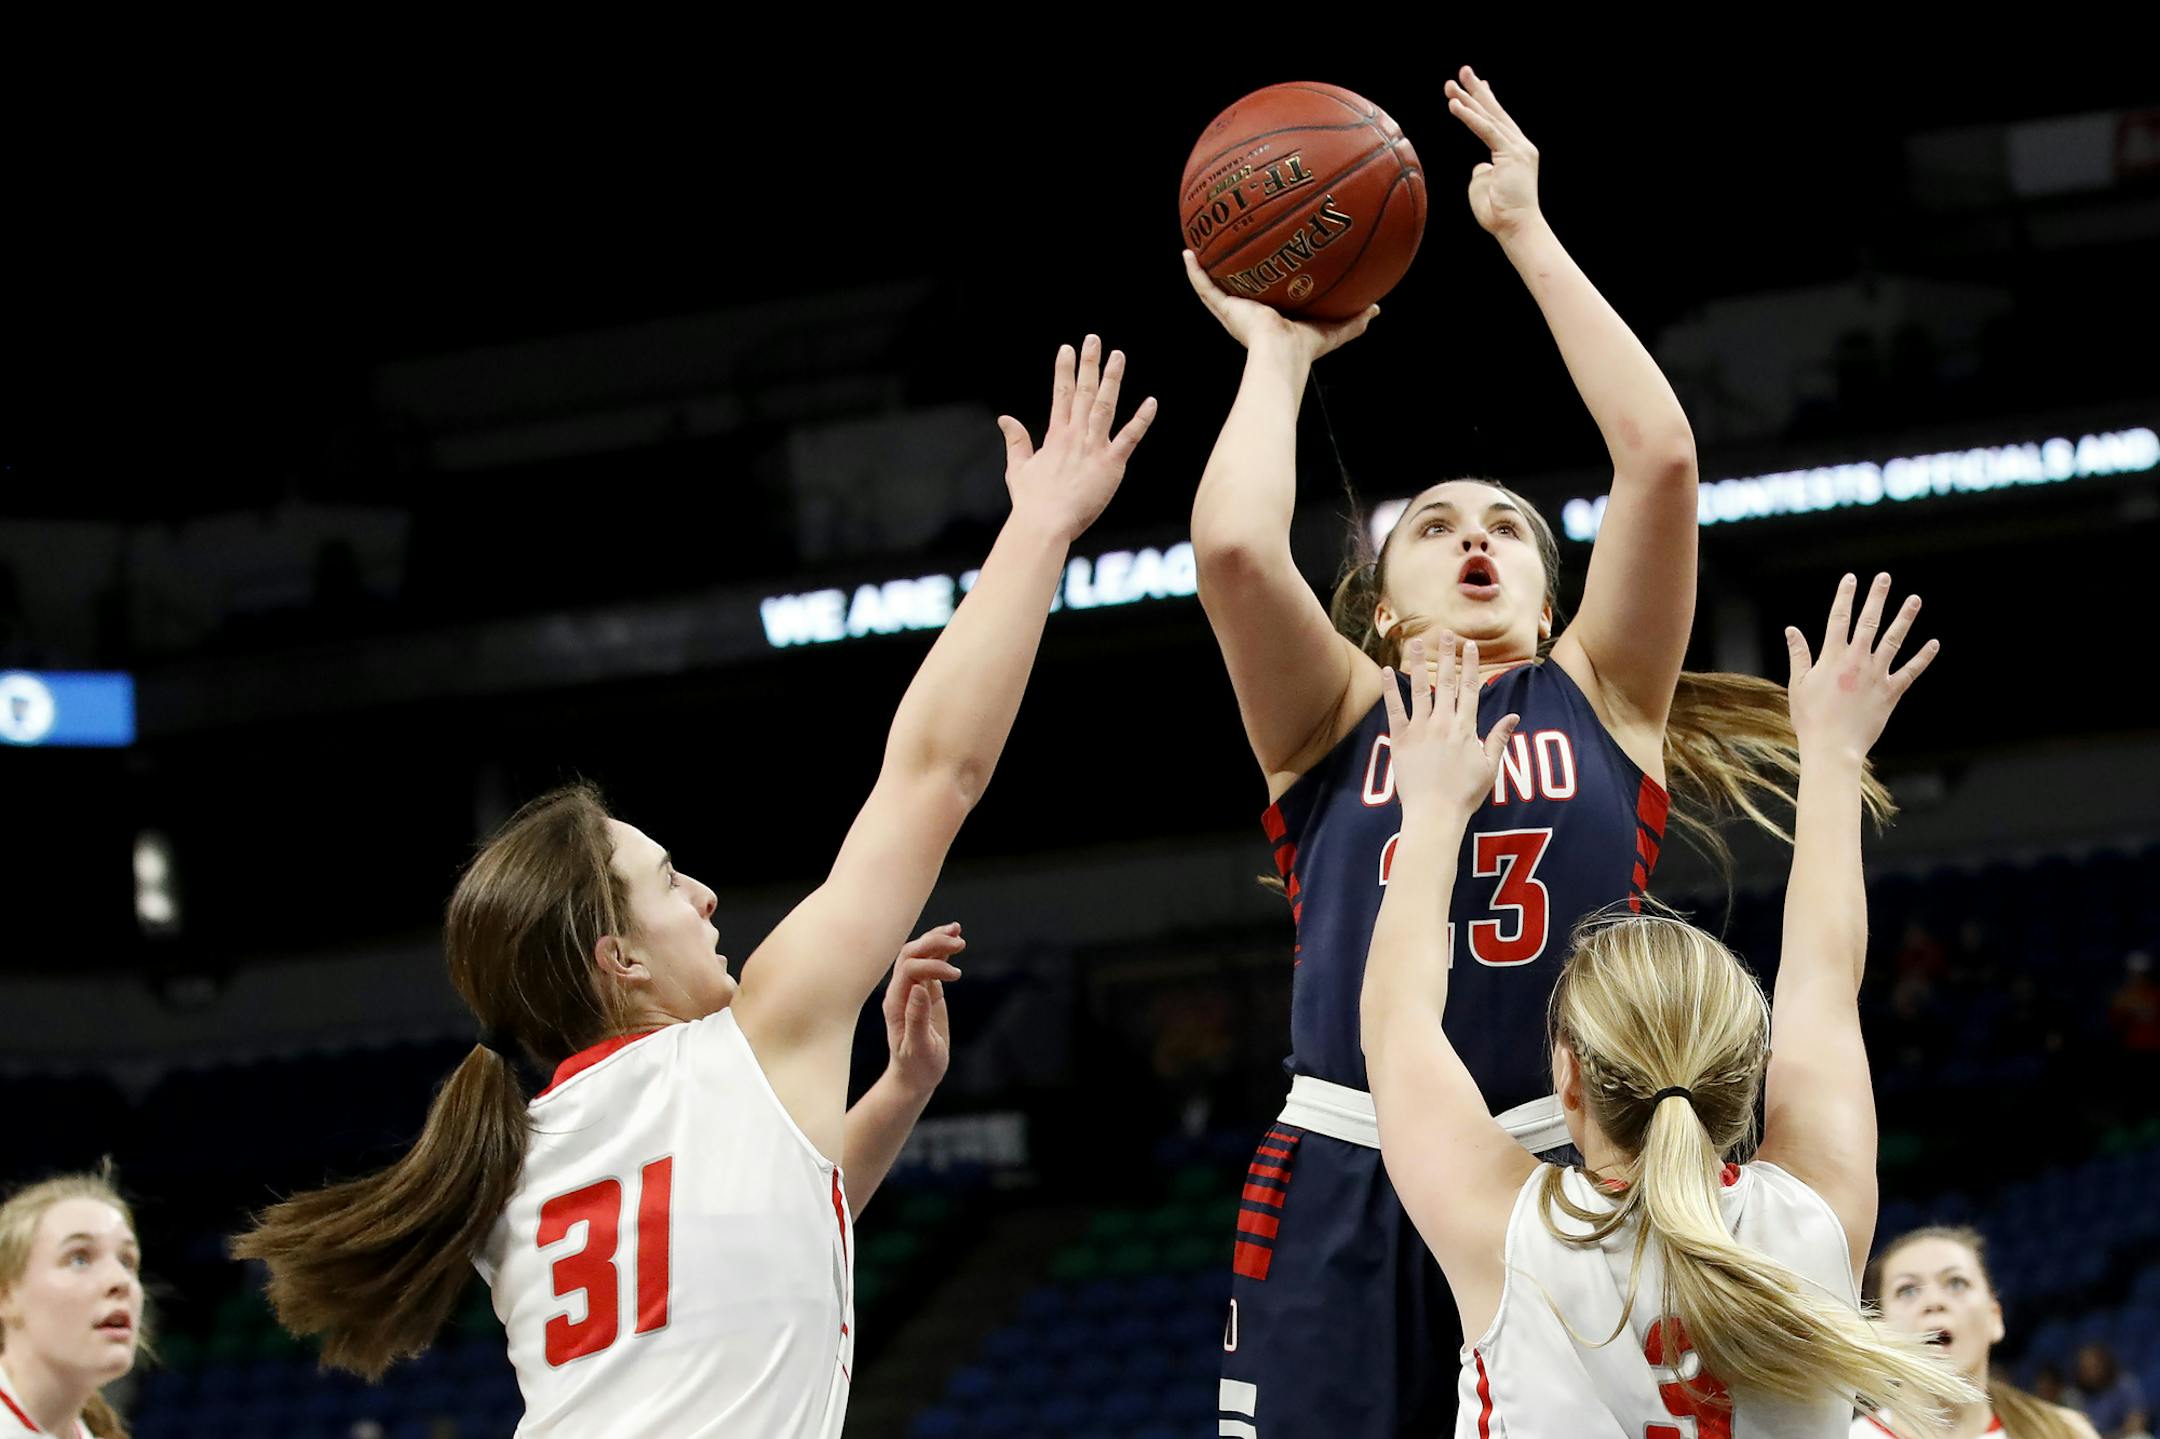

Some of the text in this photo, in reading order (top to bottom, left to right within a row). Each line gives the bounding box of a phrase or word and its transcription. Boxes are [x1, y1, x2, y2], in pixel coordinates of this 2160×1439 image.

[1218, 193, 1353, 295] SPALDIN
[760, 588, 846, 648] WE
[846, 573, 955, 637] ARE
[1064, 541, 1197, 609] LEAG
[1361, 728, 1578, 807] ONO
[1379, 826, 1553, 968] 3
[535, 1154, 676, 1371] 31
